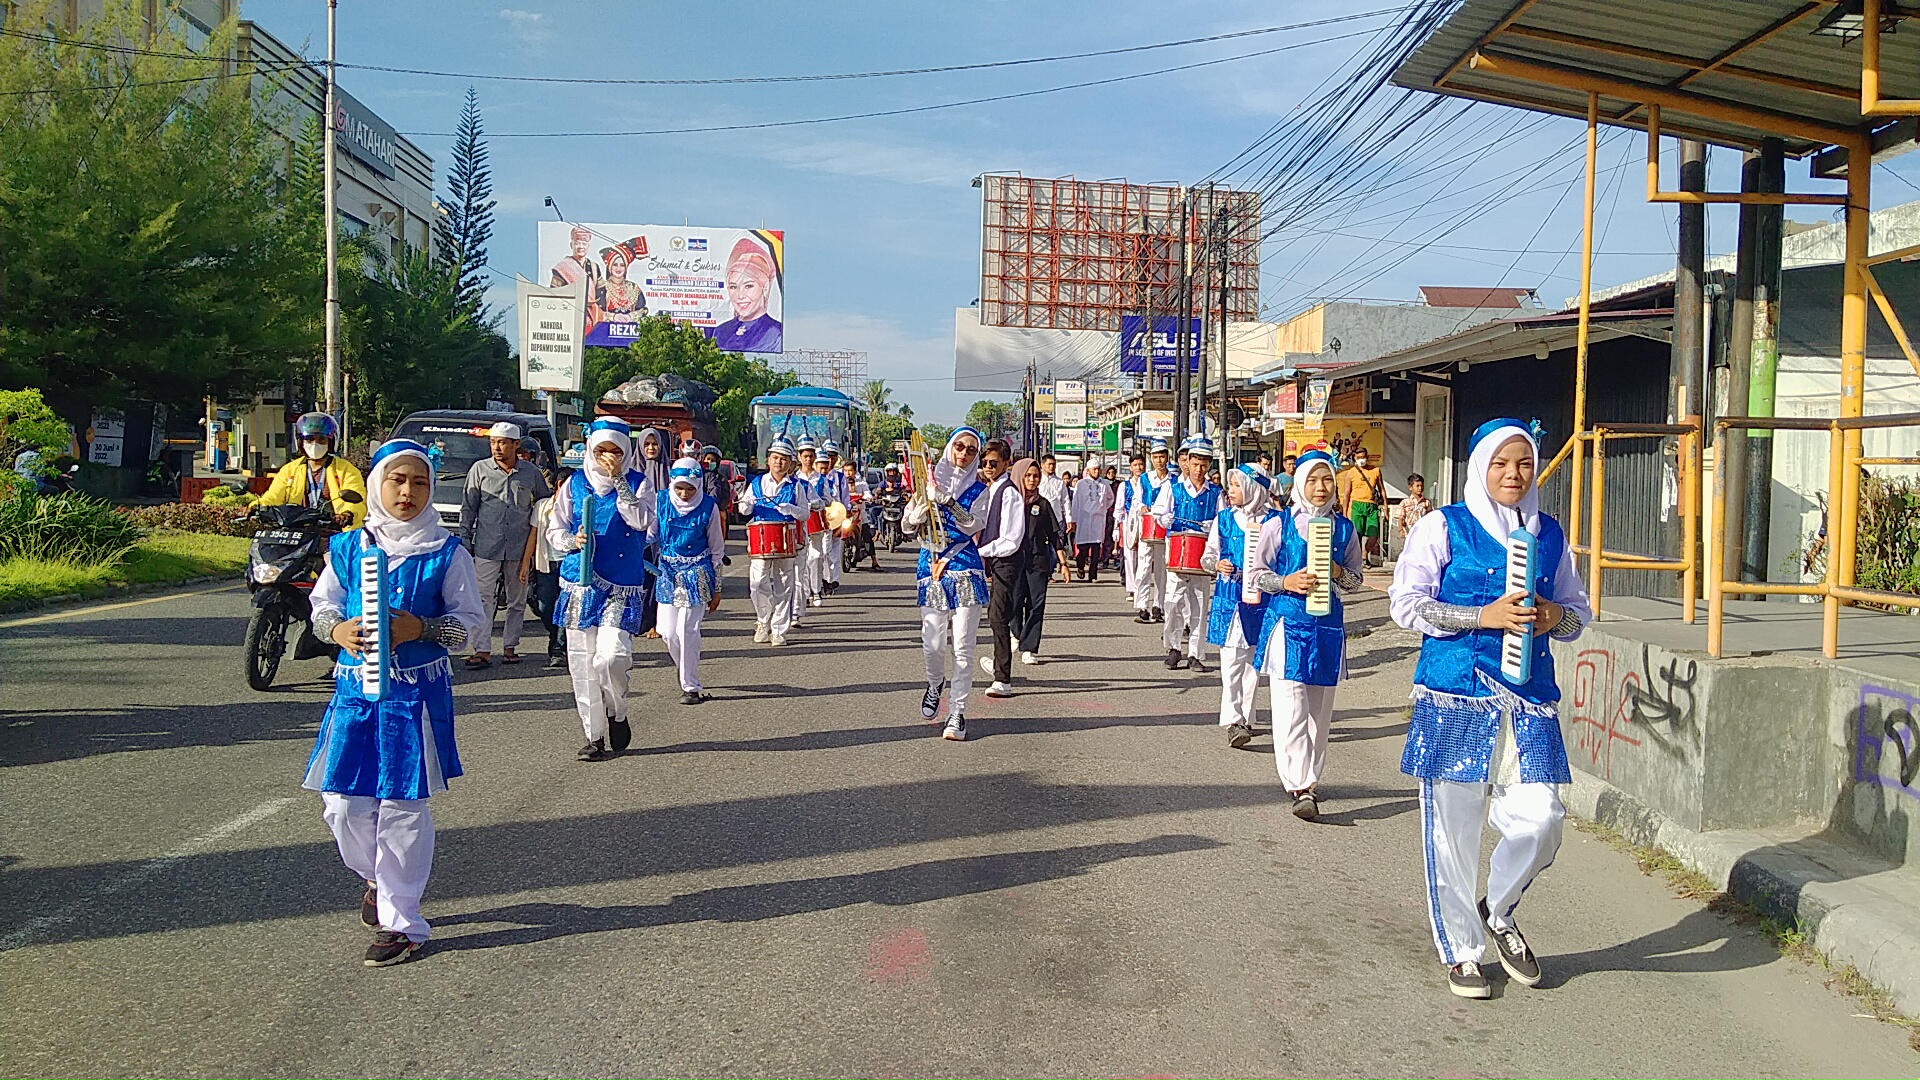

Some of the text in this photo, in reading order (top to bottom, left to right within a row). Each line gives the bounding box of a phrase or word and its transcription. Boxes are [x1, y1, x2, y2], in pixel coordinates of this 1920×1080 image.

[345, 113, 395, 168] MATAHARI
[648, 255, 721, 272] Selamat & Sukses
[540, 321, 563, 330] NARKOBA
[532, 332, 570, 341] MEMBUAT MASA
[1130, 332, 1198, 348] ASUS
[531, 343, 572, 353] DEPANMU SURAM
[95, 443, 103, 451] 30
[103, 443, 115, 452] Juni
